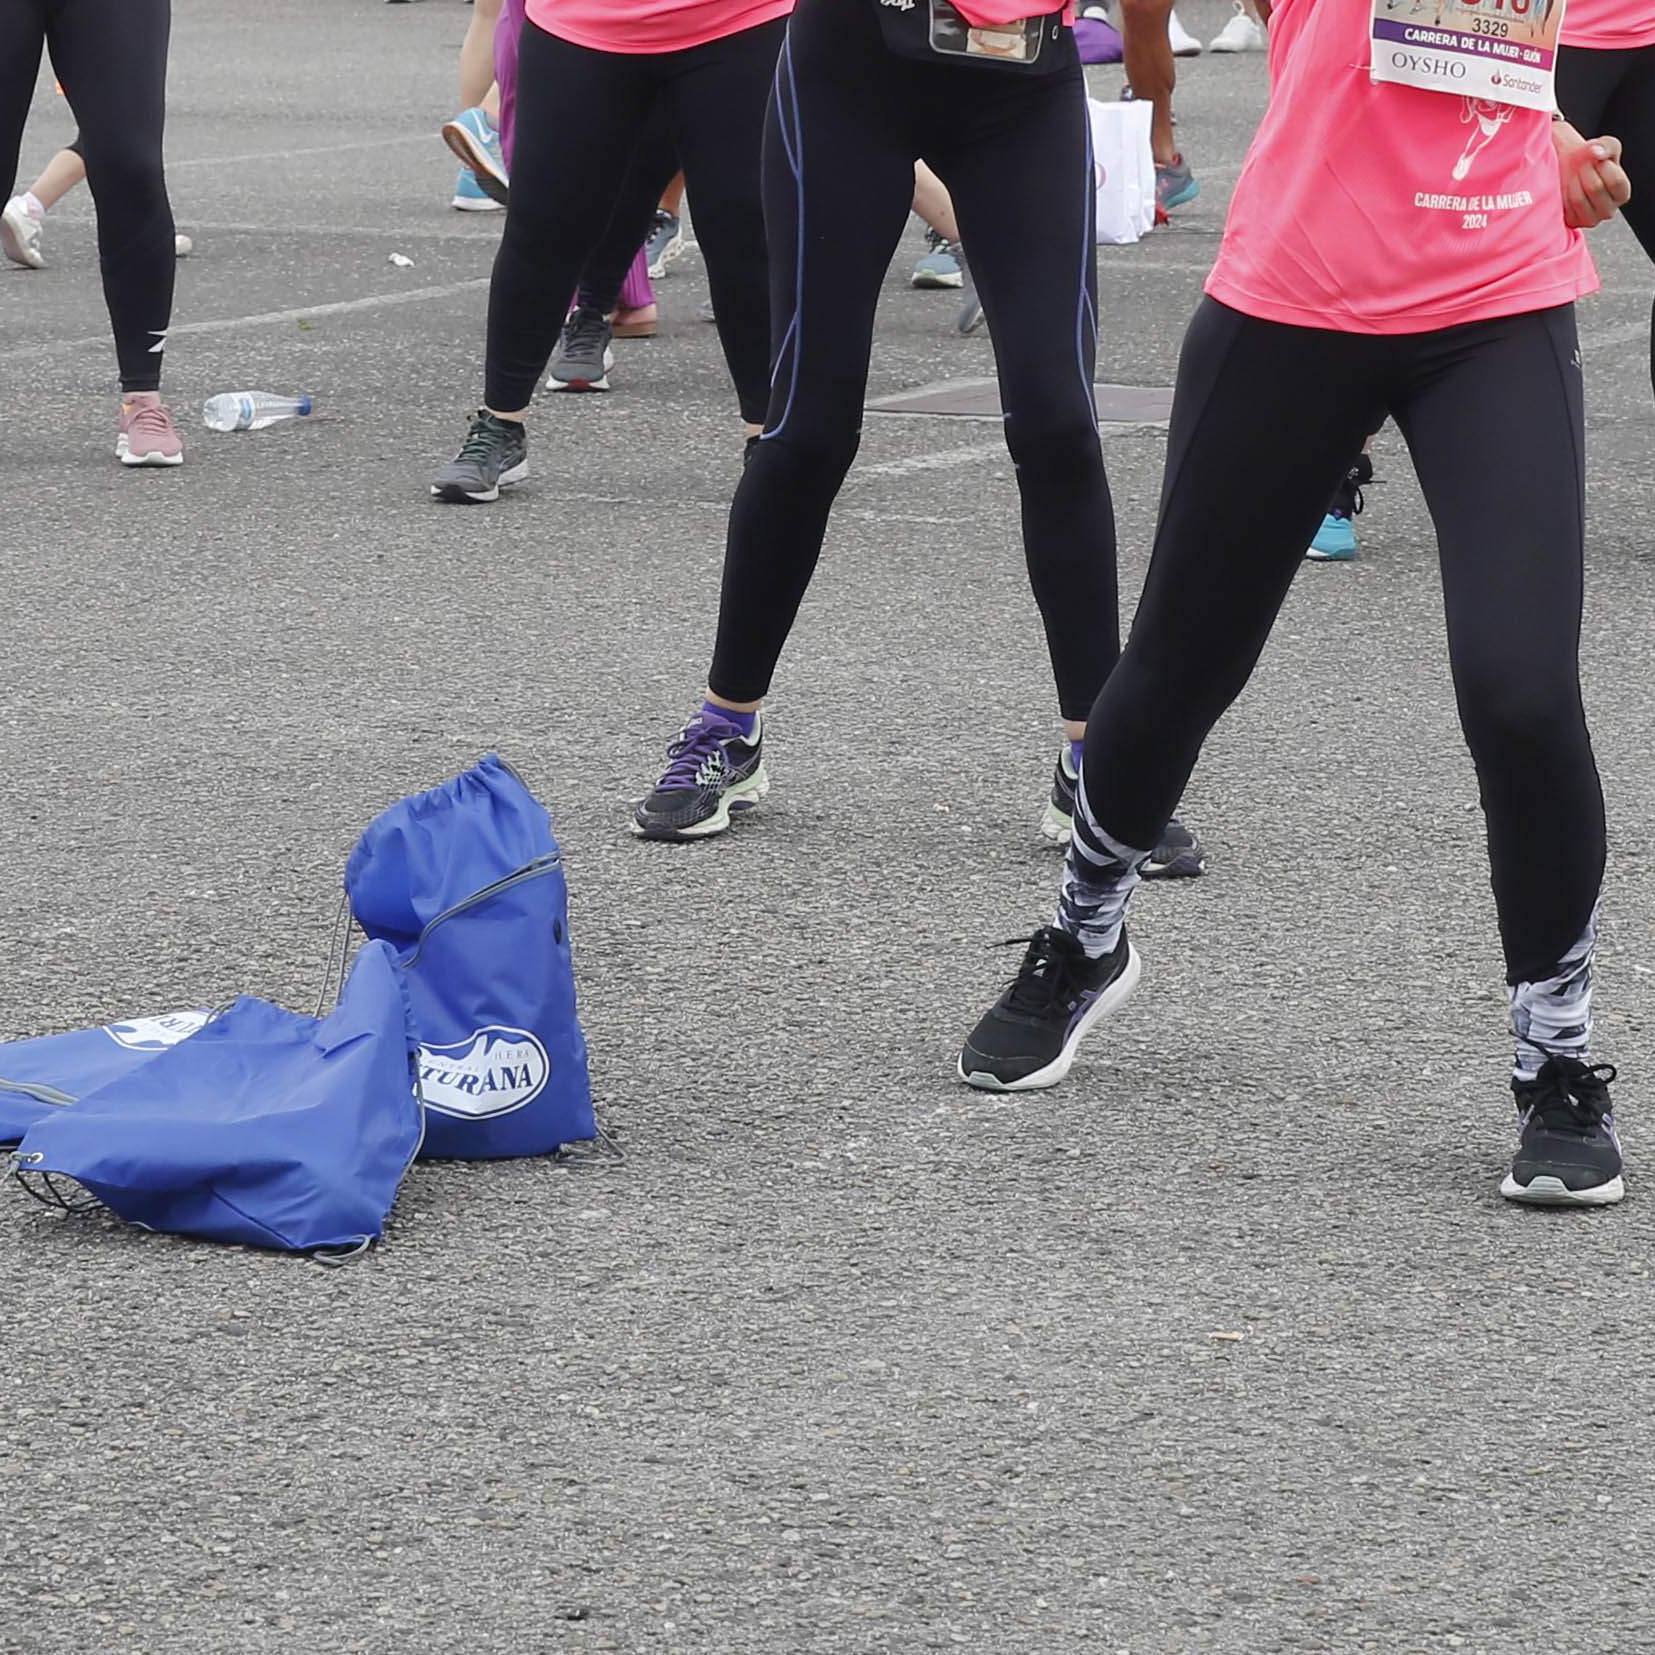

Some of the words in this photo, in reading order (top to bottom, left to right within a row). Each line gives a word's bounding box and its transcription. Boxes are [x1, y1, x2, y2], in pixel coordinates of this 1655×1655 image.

[1471, 17, 1509, 38] 3329
[1404, 28, 1458, 48] CARRERA
[1460, 36, 1476, 51] DE
[1477, 39, 1491, 54] LA
[1391, 51, 1467, 80] OYSHO
[1502, 75, 1544, 94] Santander
[1415, 192, 1467, 212] CARRERA
[1468, 195, 1481, 211] DE
[1481, 195, 1494, 211] LA
[1495, 190, 1533, 210] MUJER
[1462, 213, 1488, 229] 2024
